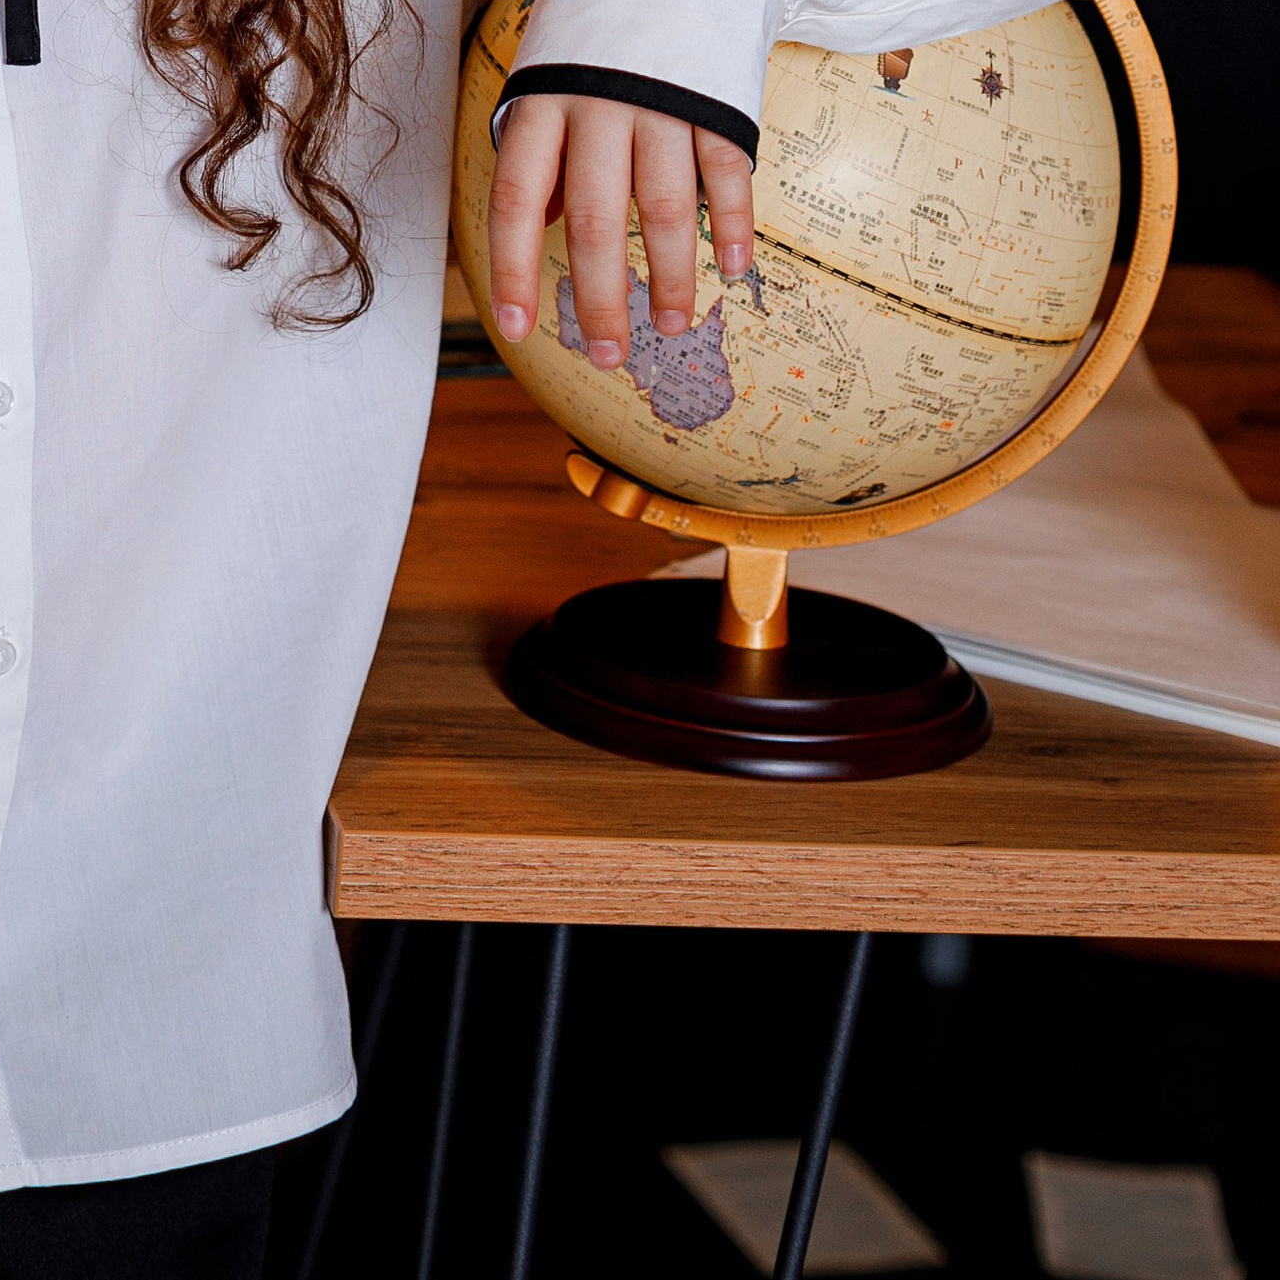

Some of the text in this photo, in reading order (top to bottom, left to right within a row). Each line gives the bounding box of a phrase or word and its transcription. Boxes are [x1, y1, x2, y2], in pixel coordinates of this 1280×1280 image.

[921, 109, 934, 126] 太
[954, 157, 1070, 204] PACIFIC
[808, 202, 846, 223] MICRONESIA
[910, 208, 941, 224] MARSHALL
[854, 258, 870, 270] 160°
